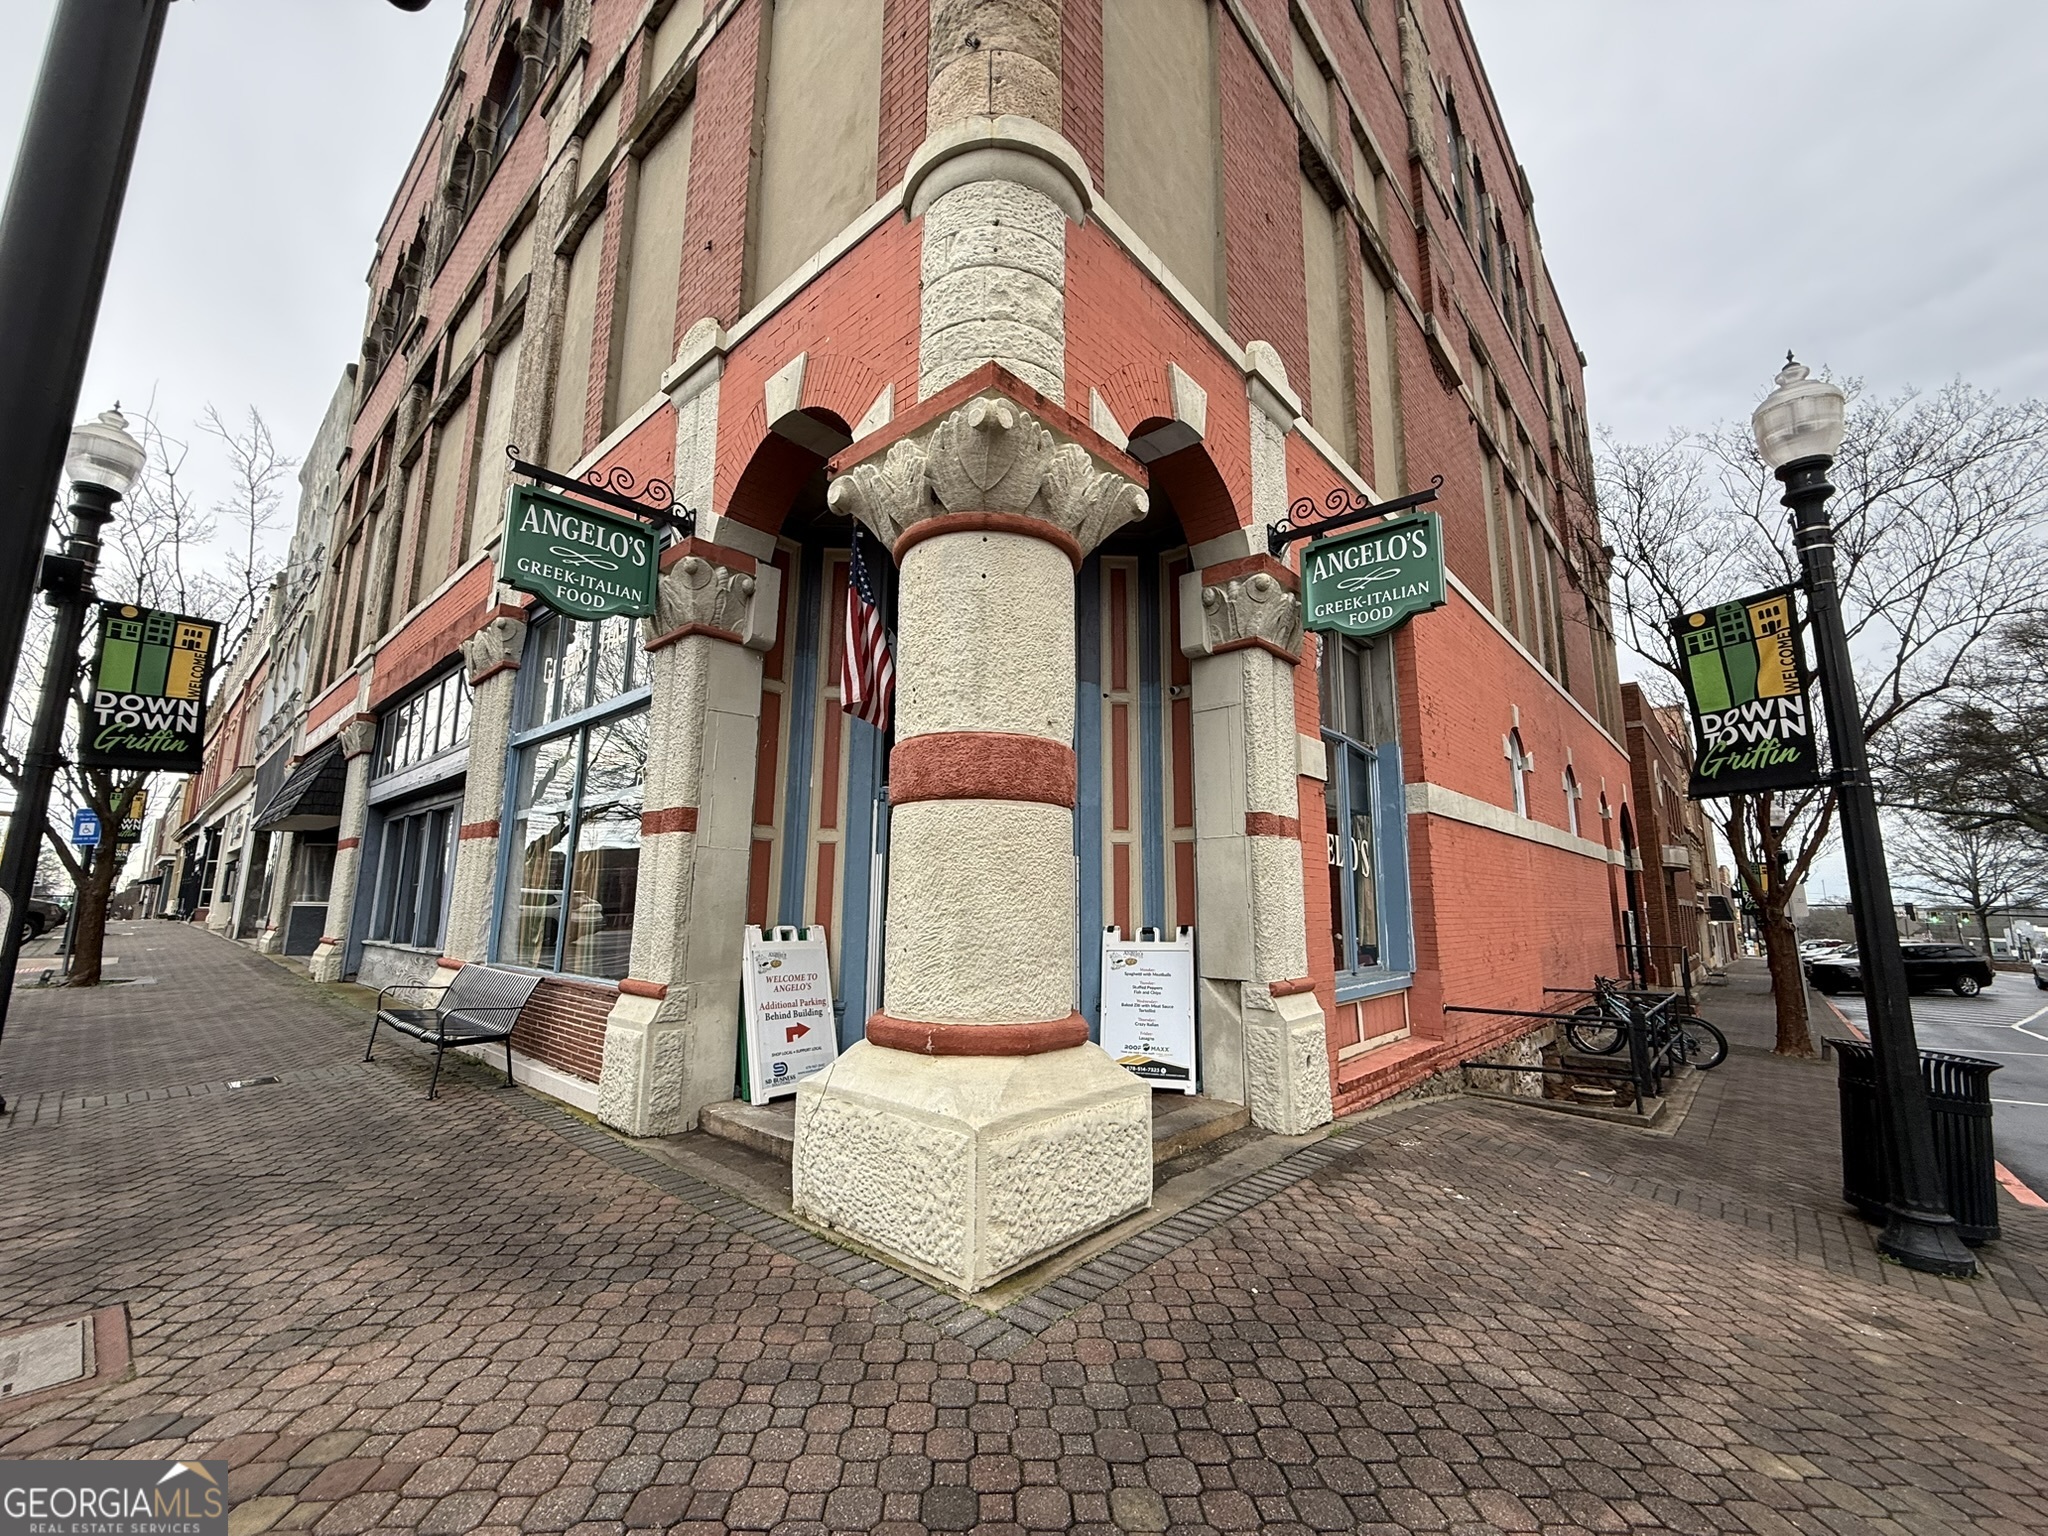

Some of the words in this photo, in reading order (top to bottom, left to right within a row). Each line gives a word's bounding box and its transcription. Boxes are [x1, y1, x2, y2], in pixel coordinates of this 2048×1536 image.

[520, 504, 646, 567] ANGELO'S
[1312, 529, 1427, 584] ANGELO'S
[517, 557, 642, 602] GREEK-ITALIAN
[557, 585, 605, 608] FOOD
[1314, 581, 1430, 617] GREEK-ITALIAN
[1349, 606, 1393, 625] FOOD
[187, 652, 207, 699] WELCOME
[1777, 631, 1800, 693] WELCOME
[94, 708, 197, 733] TOWN
[95, 691, 199, 717] DOWN
[1701, 695, 1804, 734] DOWN
[94, 722, 189, 753] Griffin
[1703, 716, 1806, 751] TOWN
[1700, 738, 1801, 779] Griffin
[766, 974, 806, 983] WELCOME
[807, 973, 818, 981] TO
[773, 983, 812, 992] ANGELO'S
[759, 999, 798, 1011] Additional
[799, 997, 827, 1007] Parking
[765, 1010, 791, 1021] Behind
[793, 1008, 823, 1018] Building
